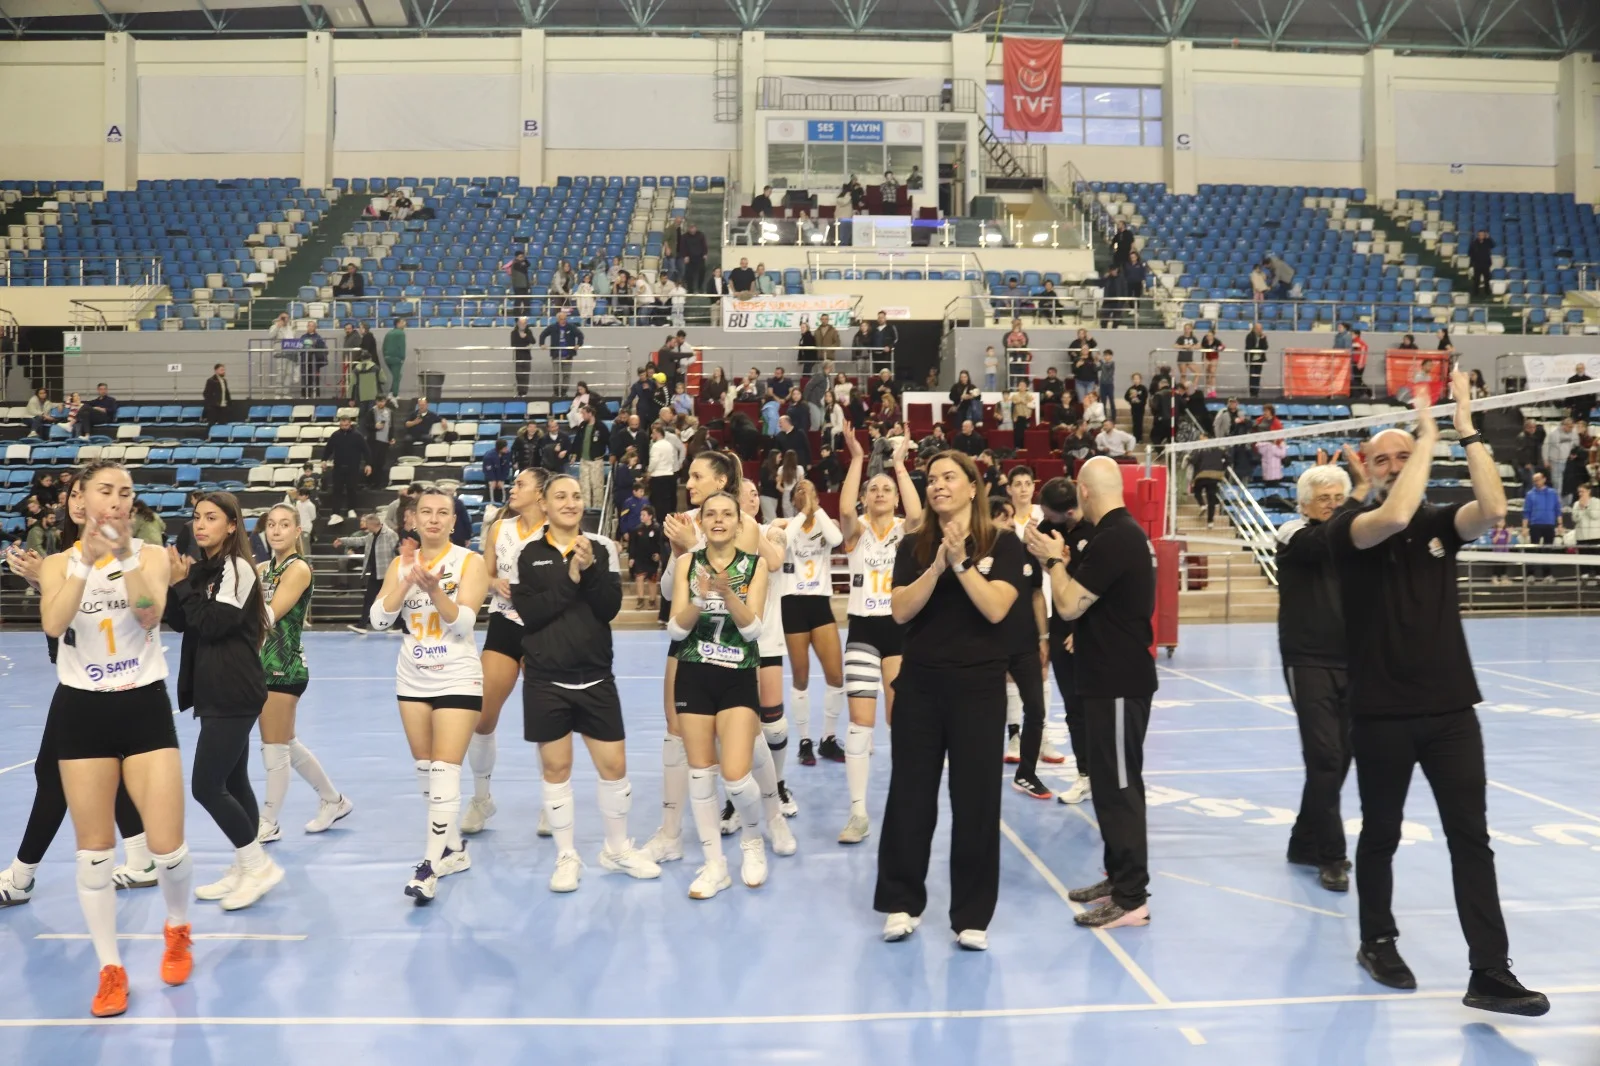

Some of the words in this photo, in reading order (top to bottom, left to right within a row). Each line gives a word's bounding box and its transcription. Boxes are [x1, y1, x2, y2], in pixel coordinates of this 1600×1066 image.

[1012, 95, 1054, 113] TVF
[107, 125, 122, 137] A
[524, 119, 538, 131] B
[817, 122, 834, 132] SES
[850, 123, 880, 133] YAYIN
[1177, 133, 1190, 145] C
[728, 313, 749, 328] BU
[754, 313, 793, 328] SENE
[804, 560, 815, 579] 3
[411, 612, 443, 641] 54
[710, 616, 725, 644] 7
[98, 618, 117, 656] 1
[106, 658, 139, 674] SAYIN
